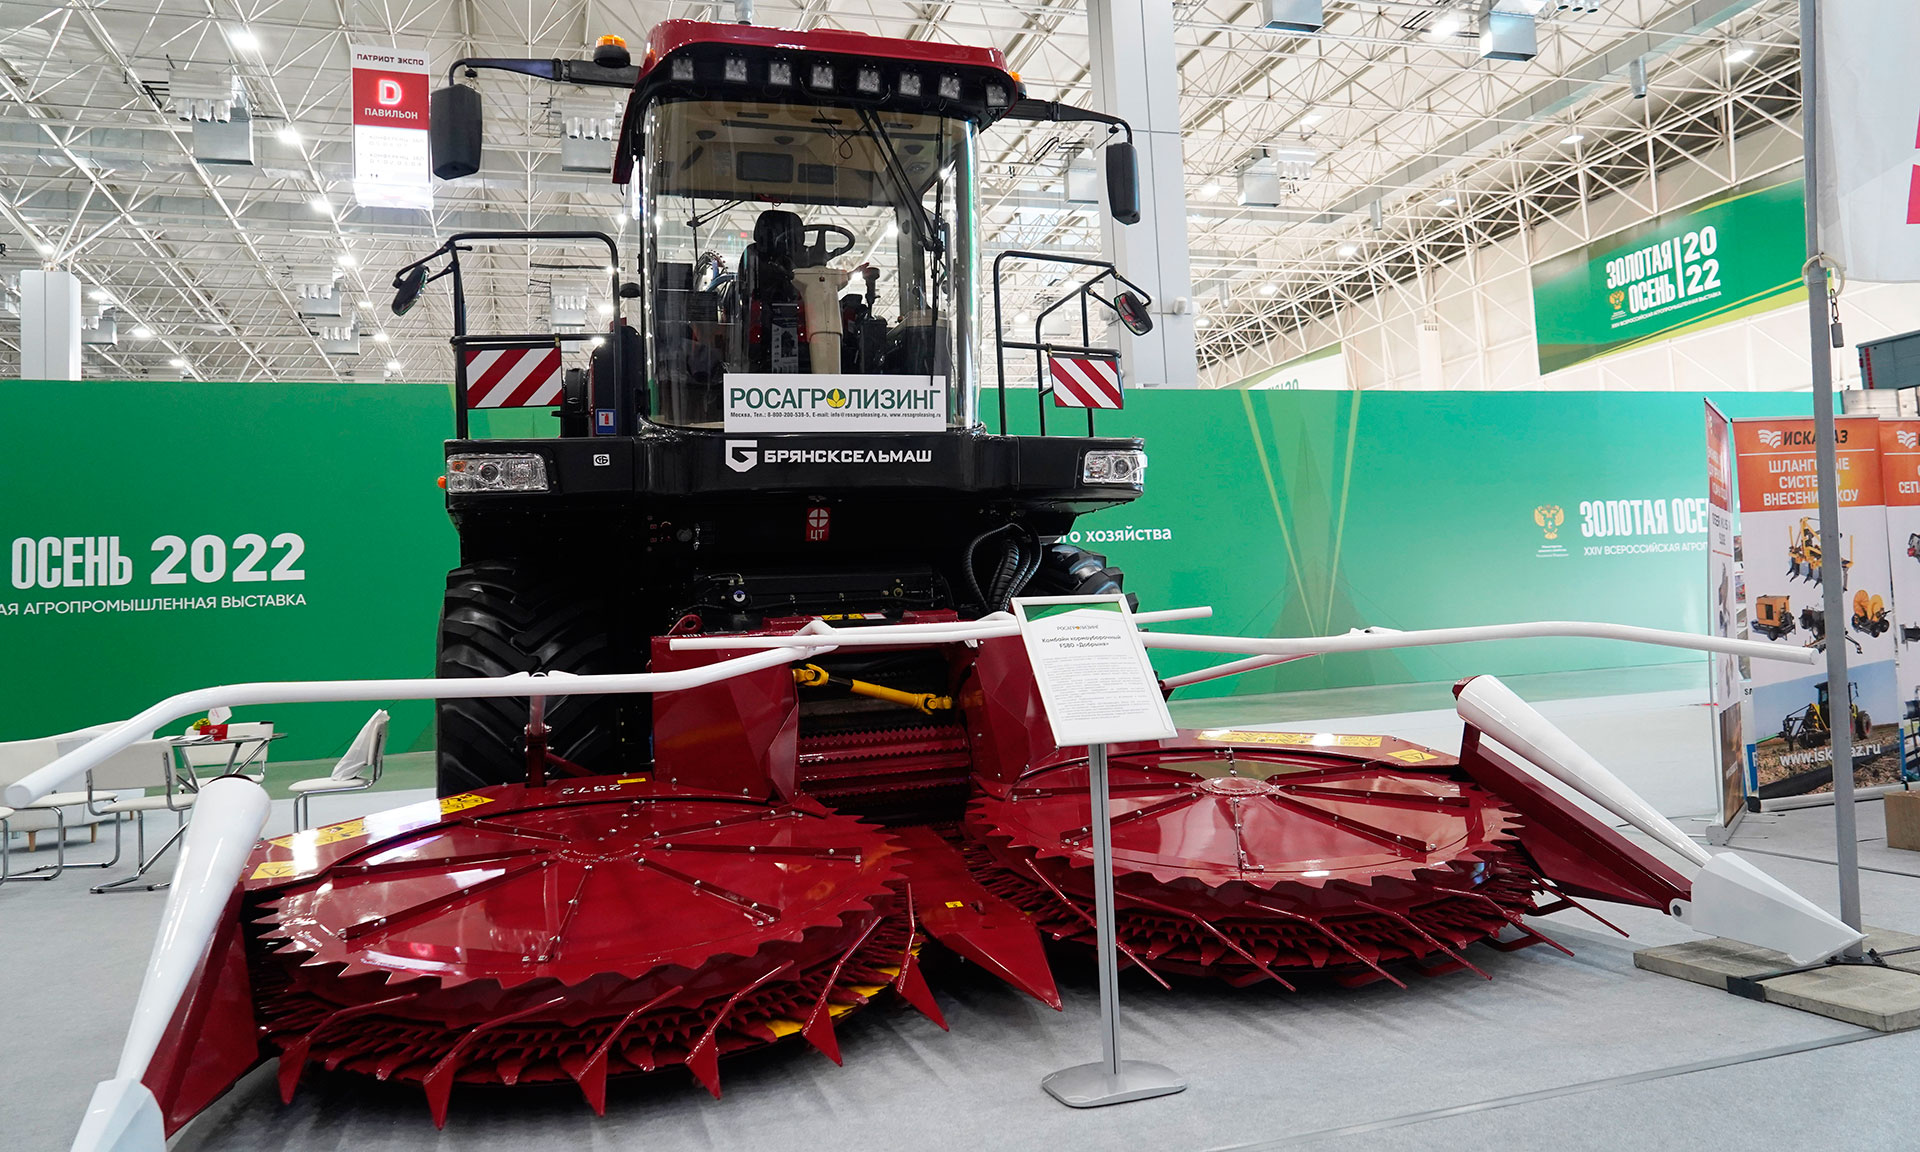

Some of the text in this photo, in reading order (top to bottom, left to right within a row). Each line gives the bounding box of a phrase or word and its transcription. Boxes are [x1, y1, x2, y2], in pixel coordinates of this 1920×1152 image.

[357, 54, 424, 66] ПАТРИОТ ЭКСПО
[378, 79, 402, 105] D
[364, 108, 418, 120] ПАВИЛЬОН
[1683, 226, 1717, 263] 20
[1606, 240, 1673, 289] ЗОЛОТАЯ
[1686, 258, 1721, 296] 22
[1628, 274, 1676, 314] ОСЕНЬ
[730, 388, 941, 409] РОСАГРОЛИЗИНГ
[764, 449, 932, 463] БРЯНСКСЕЛЬМАШ
[1763, 491, 1819, 506] ВНЕСЕНИ
[1580, 499, 1669, 537] ЗОЛОТАЯ
[1671, 498, 1708, 535] ОСЕ
[810, 529, 825, 541] ЦТ
[1086, 525, 1172, 543] хозяйства
[1584, 545, 1603, 556] XXIV
[1604, 542, 1681, 556] ВСЕРОССИЙСКАЯ
[11, 533, 305, 589] ОСЕНЬ 2022
[23, 597, 217, 615] АГРОПРОМЫШЛЕННАЯ
[221, 594, 307, 609] ВЫСТАВКА
